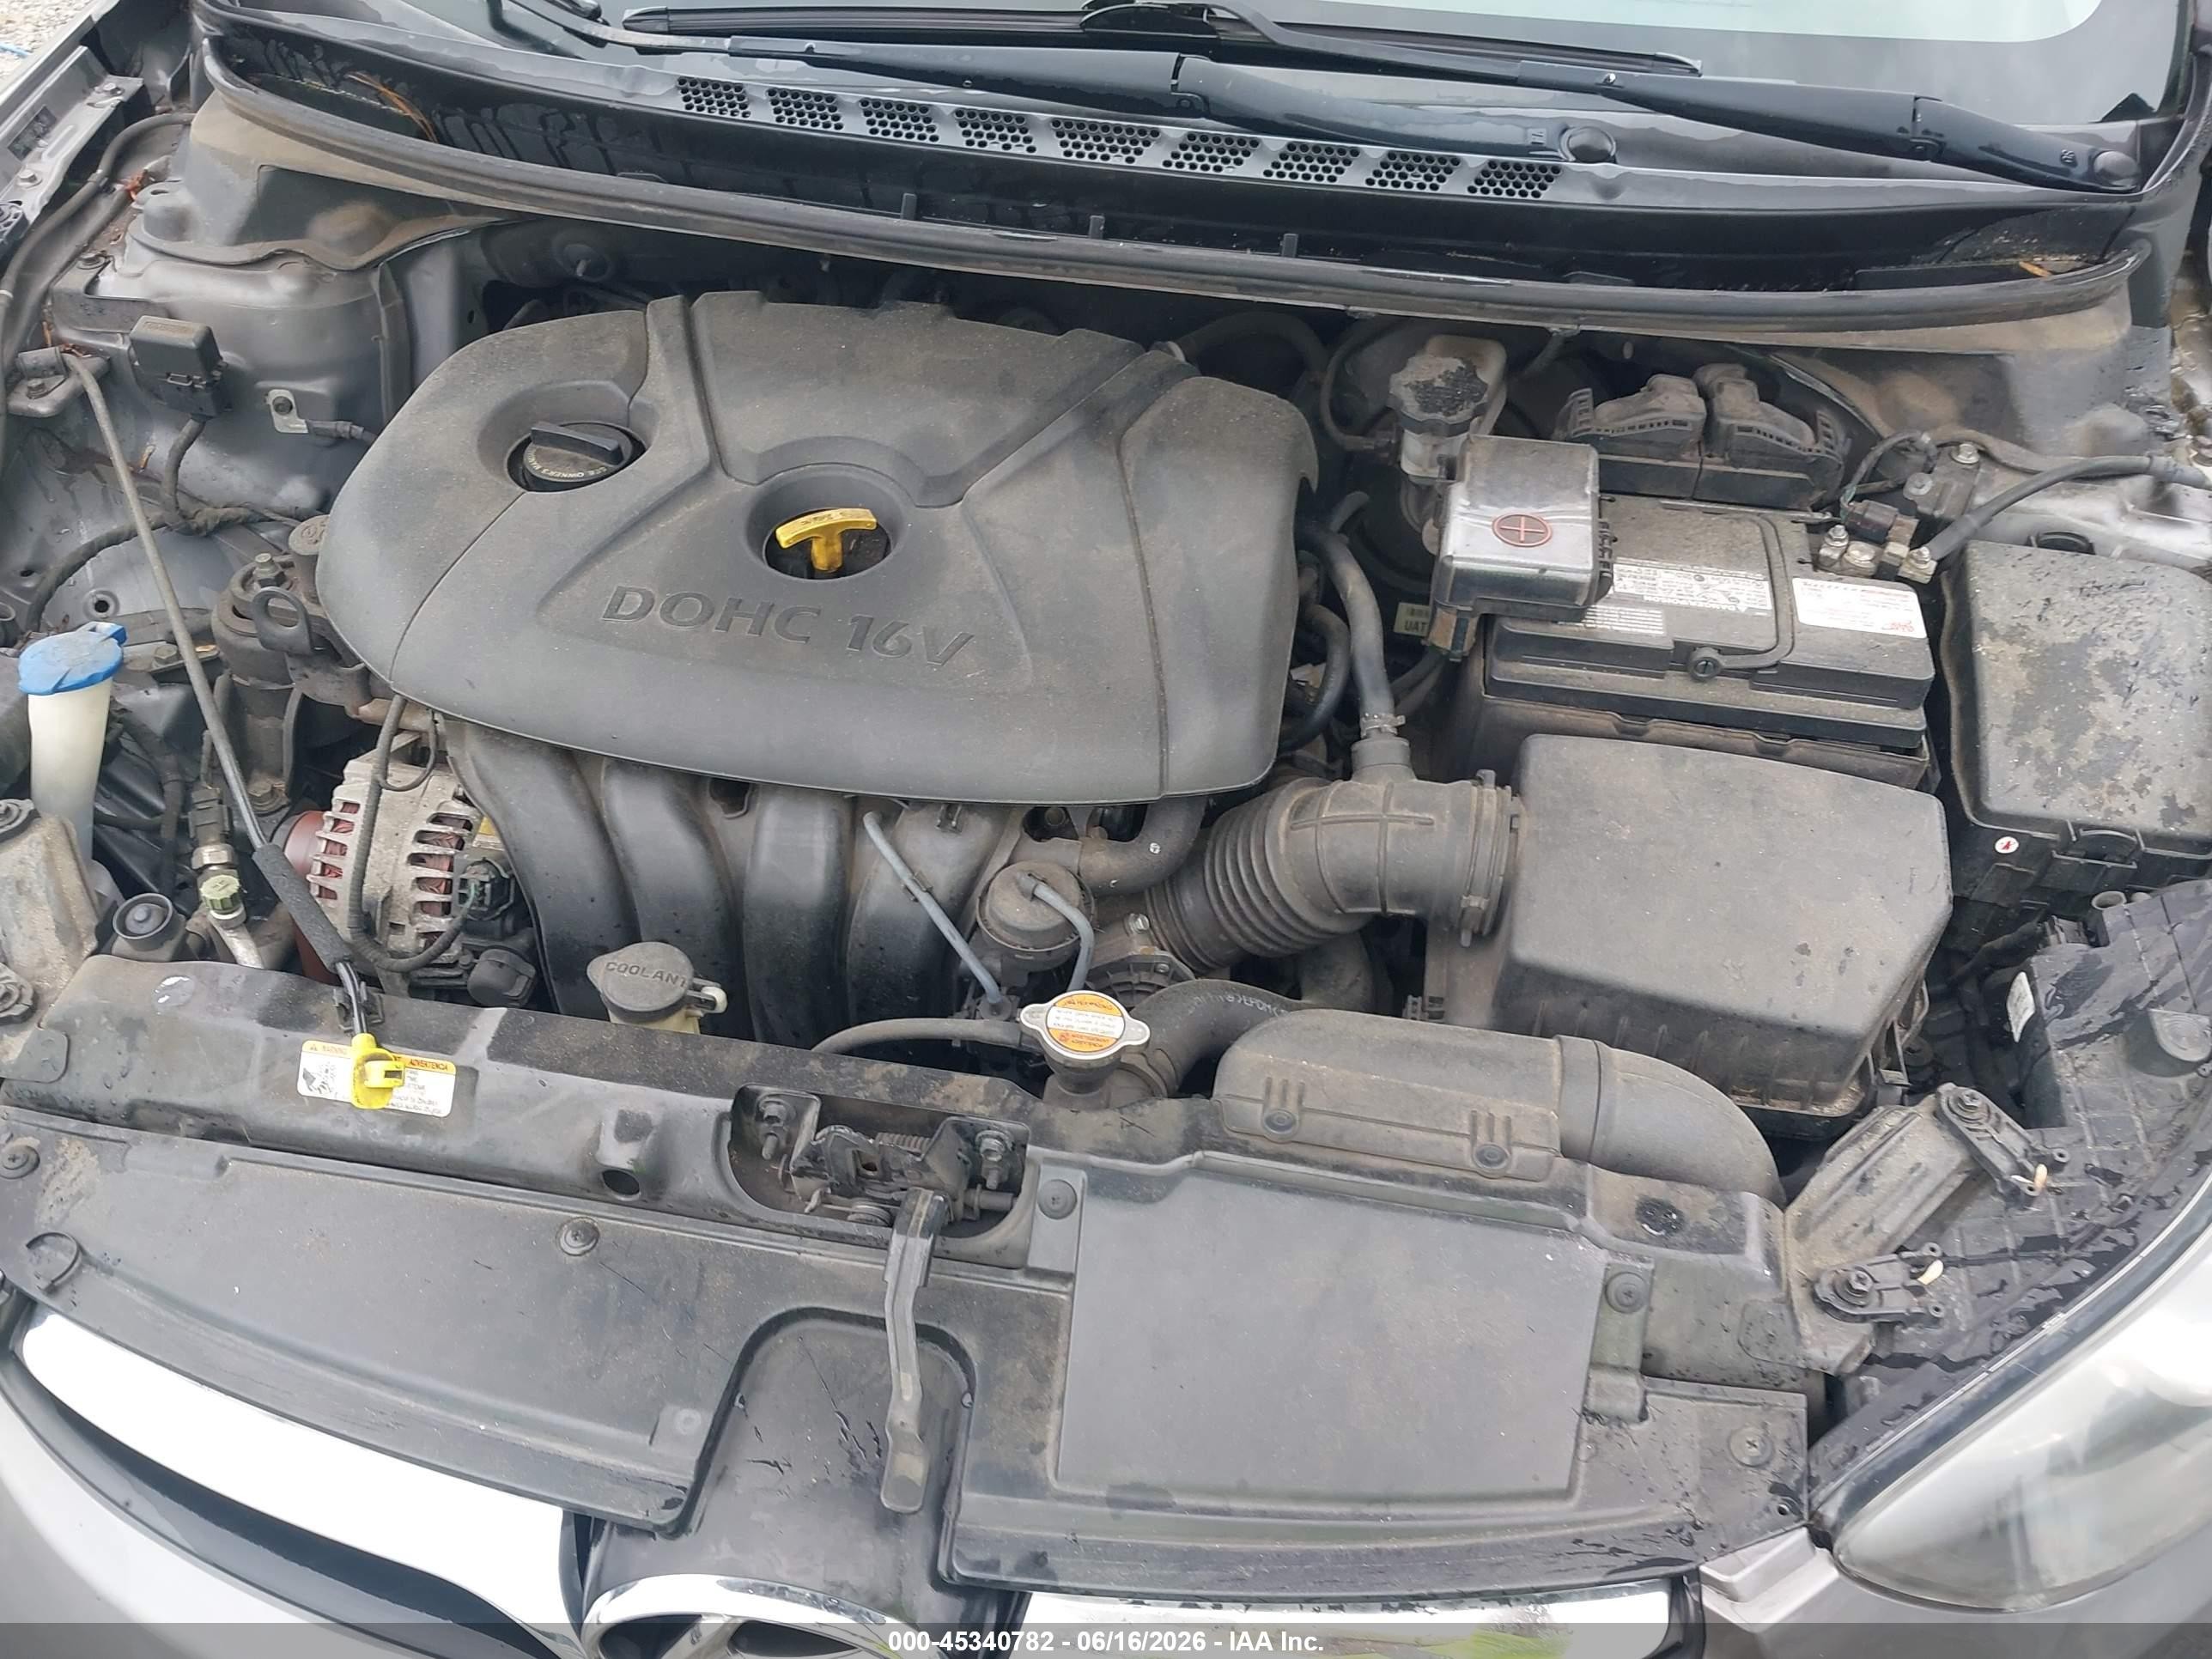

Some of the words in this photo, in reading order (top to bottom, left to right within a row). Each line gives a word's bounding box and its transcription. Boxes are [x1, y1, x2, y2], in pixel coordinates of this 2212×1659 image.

[601, 585, 822, 645] DOHC
[846, 613, 975, 666] 16V
[605, 961, 688, 988] COOLANT
